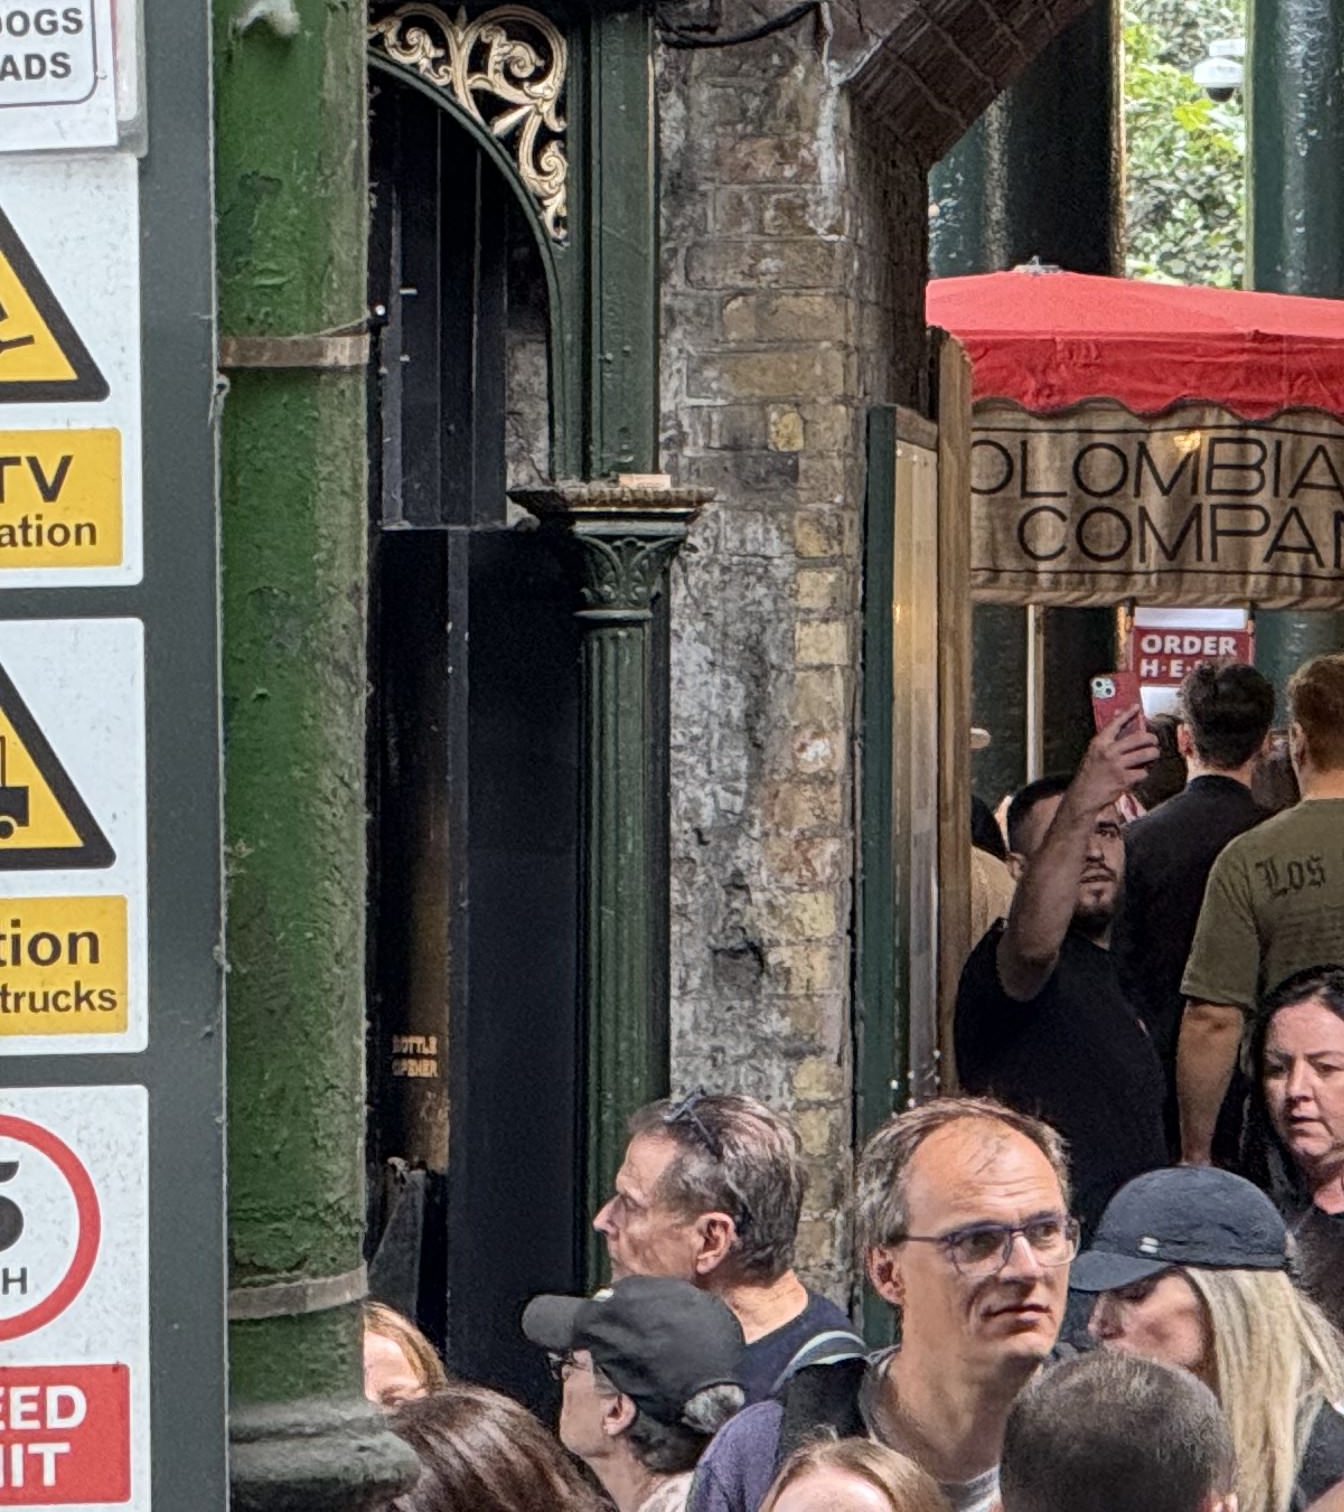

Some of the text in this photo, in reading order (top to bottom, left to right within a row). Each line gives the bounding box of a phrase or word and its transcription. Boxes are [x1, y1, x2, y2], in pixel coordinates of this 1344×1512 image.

[0, 7, 84, 37] OGS
[0, 52, 72, 81] ADS
[0, 514, 97, 547] ation
[1140, 633, 1238, 657] ORDER
[1254, 854, 1326, 901] Los
[0, 979, 118, 1014] trucks
[0, 1384, 87, 1430] ED
[0, 1441, 71, 1488] IT
